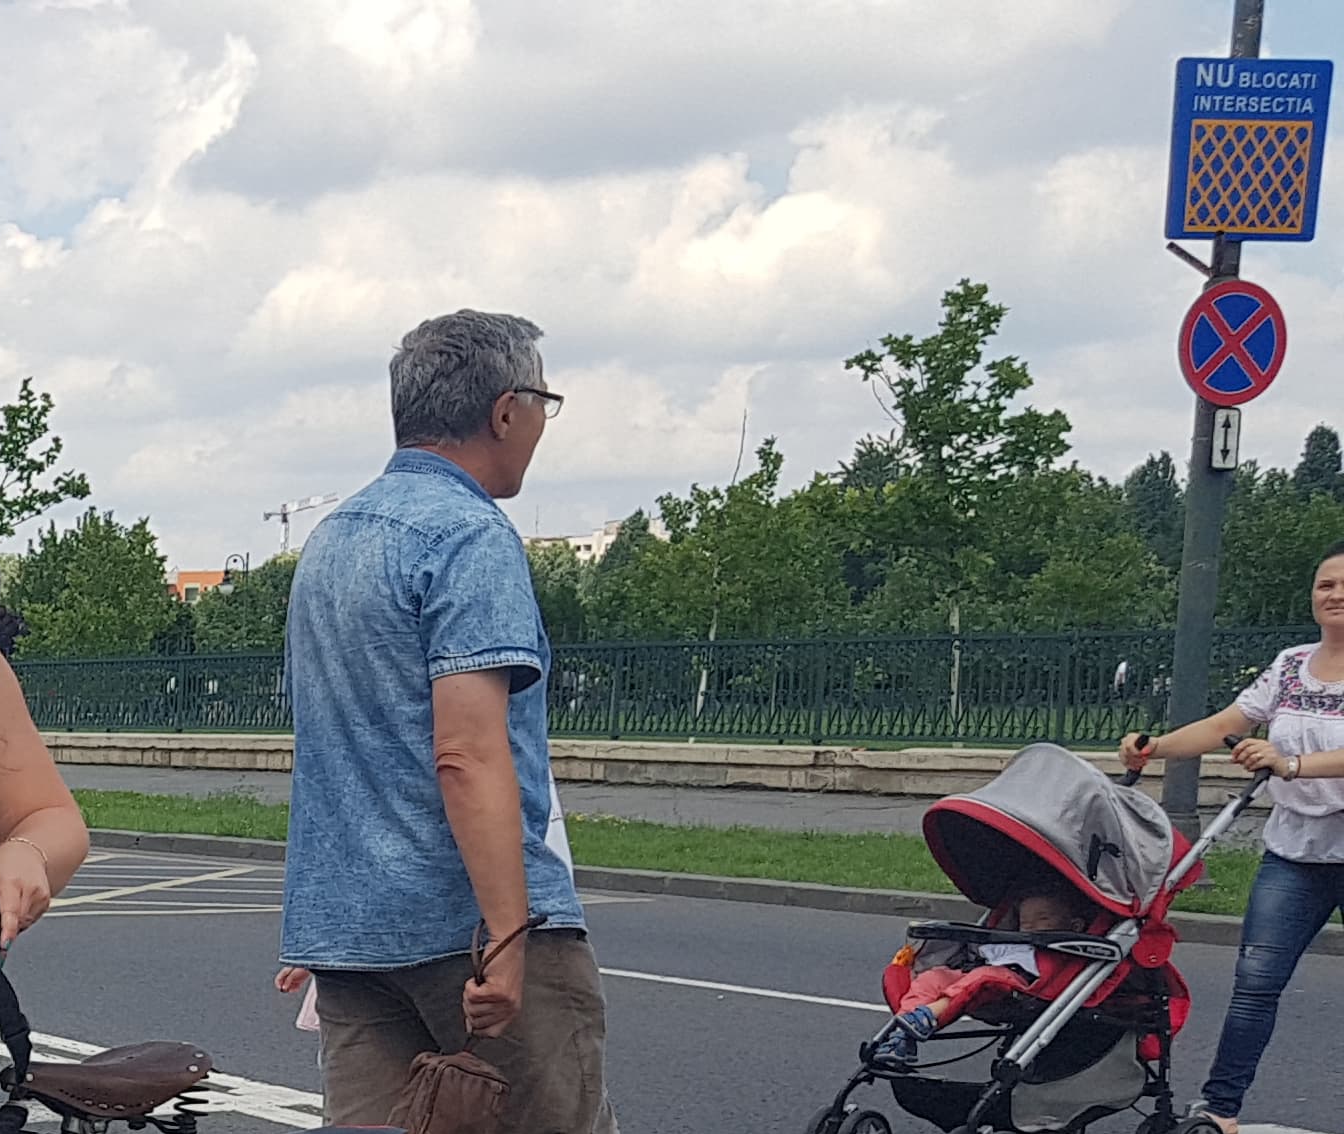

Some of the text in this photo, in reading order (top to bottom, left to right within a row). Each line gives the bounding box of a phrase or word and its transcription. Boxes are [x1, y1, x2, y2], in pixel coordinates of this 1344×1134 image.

[1196, 64, 1317, 88] NU BLOCATI
[1192, 95, 1314, 113] INTERSECTIA
